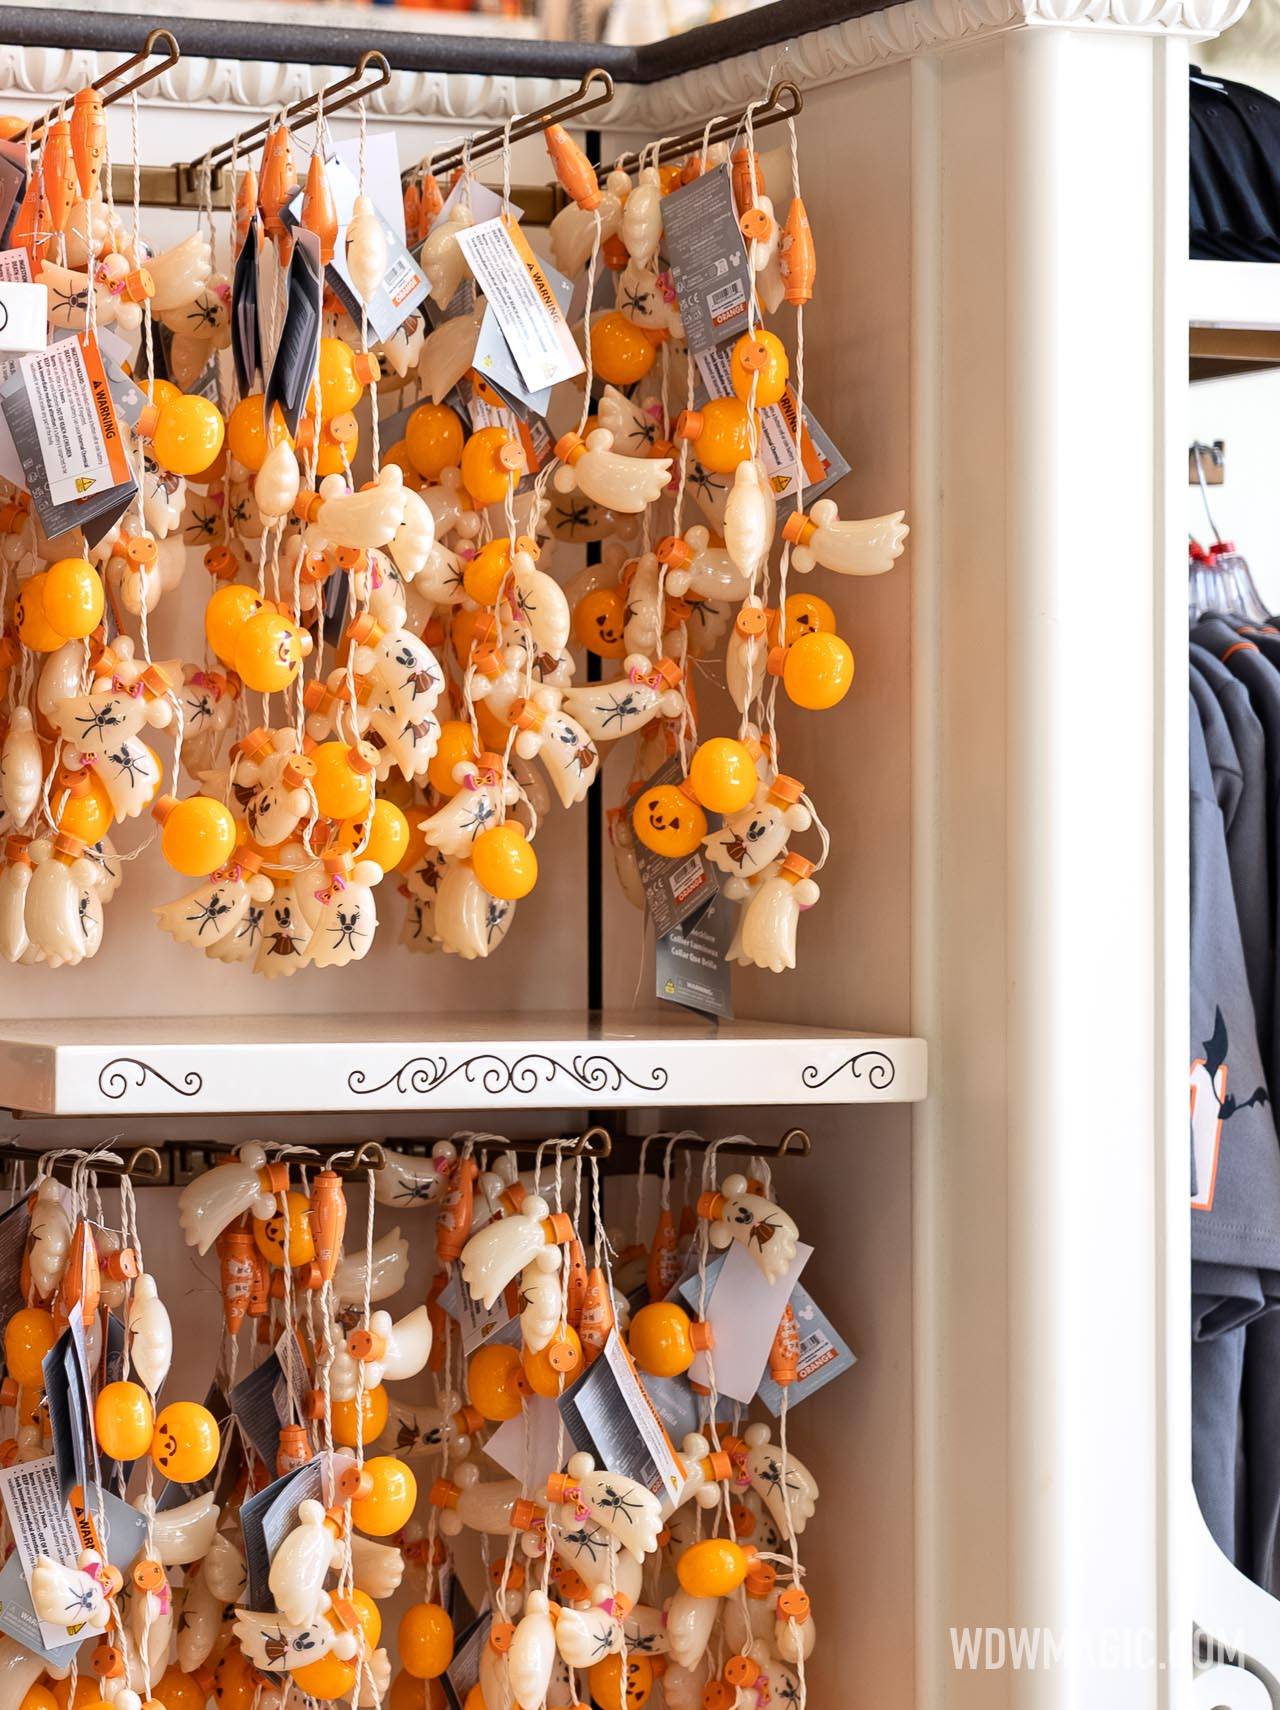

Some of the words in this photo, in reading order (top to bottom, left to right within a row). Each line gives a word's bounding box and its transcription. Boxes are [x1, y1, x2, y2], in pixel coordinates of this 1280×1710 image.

[531, 271, 562, 324] WARNING
[715, 303, 746, 325] ORANGE
[94, 389, 116, 439] WARNING
[798, 1350, 833, 1378] ORANGE
[13, 1475, 21, 1487] Seek
[16, 1487, 29, 1513] immediate
[24, 1512, 34, 1532] medical
[77, 1517, 96, 1551] WARN
[29, 1531, 40, 1554] attention
